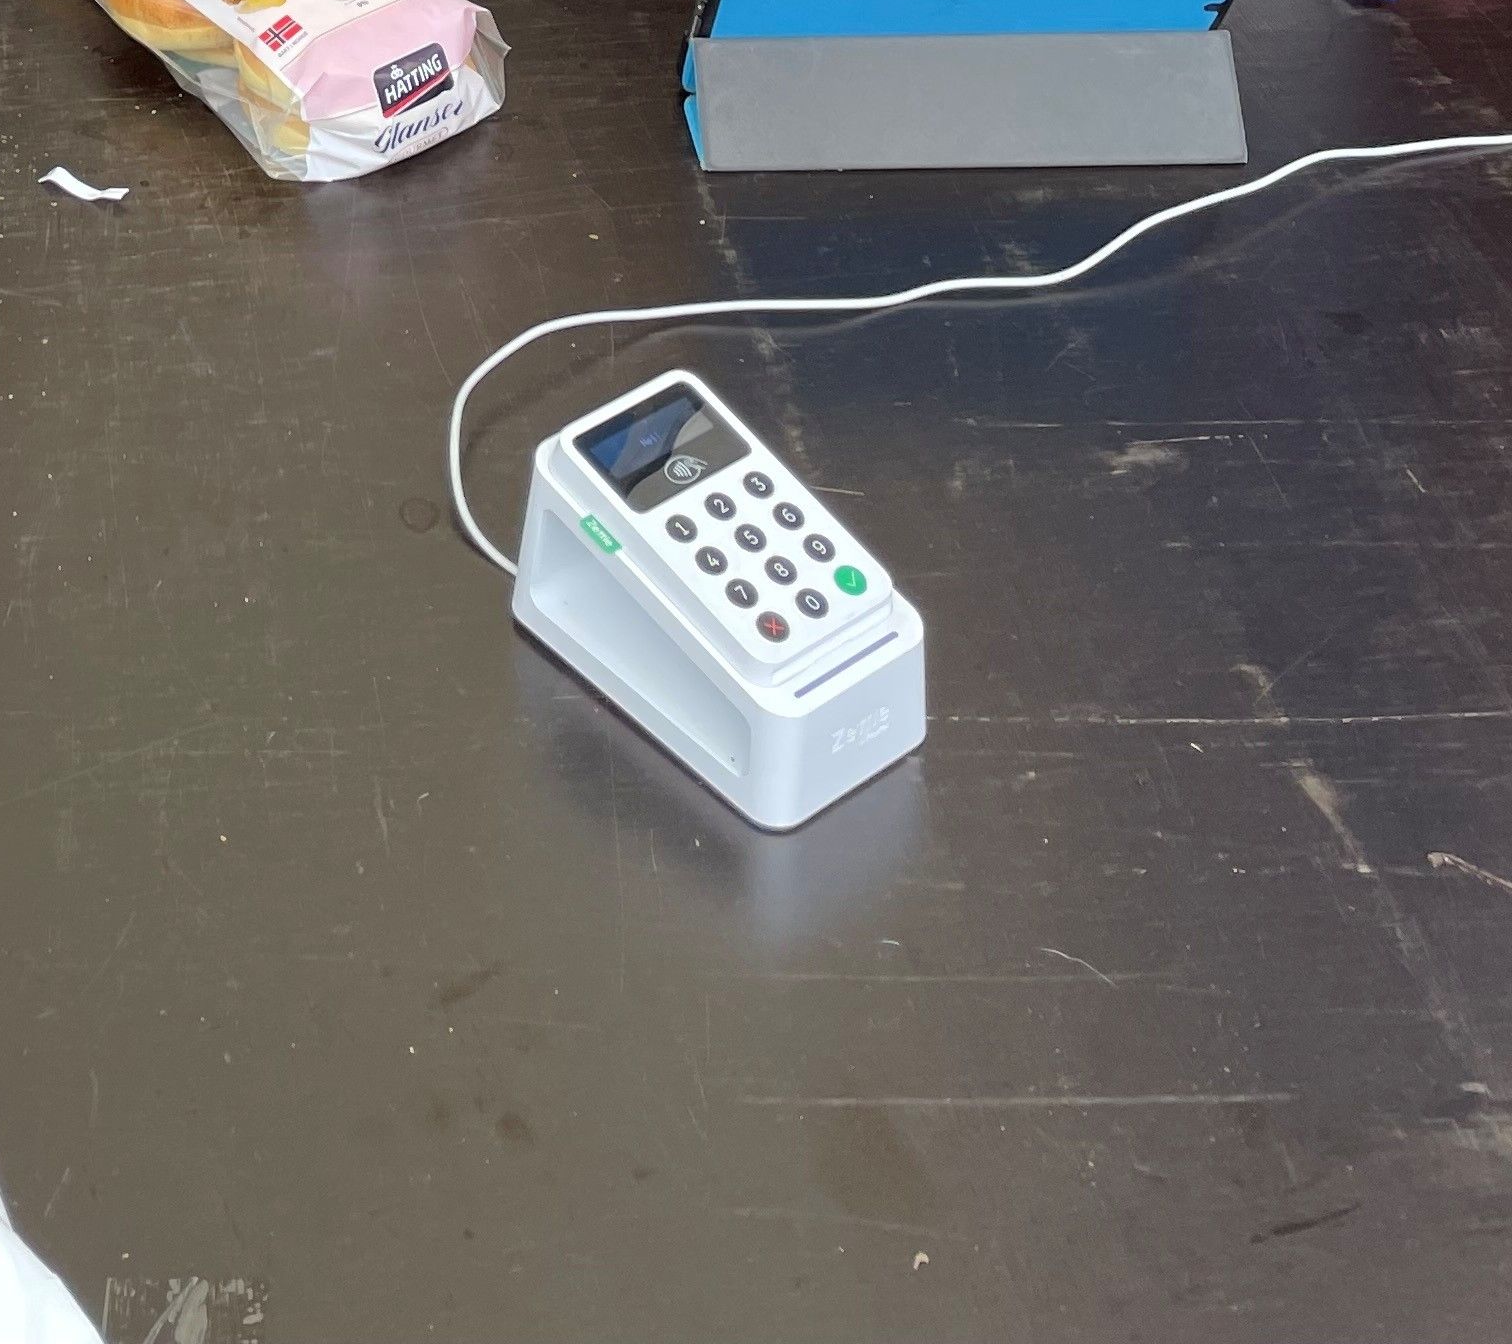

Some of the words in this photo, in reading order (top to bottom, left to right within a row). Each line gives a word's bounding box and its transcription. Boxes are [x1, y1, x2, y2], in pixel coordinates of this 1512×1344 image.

[384, 53, 443, 105] HATTING
[751, 477, 767, 491] 3
[714, 499, 729, 513] 2
[782, 508, 796, 523] 6
[675, 522, 689, 536] 1
[744, 530, 758, 545] 5
[811, 540, 827, 555] 9
[706, 552, 720, 567] 4
[773, 563, 789, 577] 8
[734, 585, 747, 600] 7
[805, 595, 821, 610] 0
